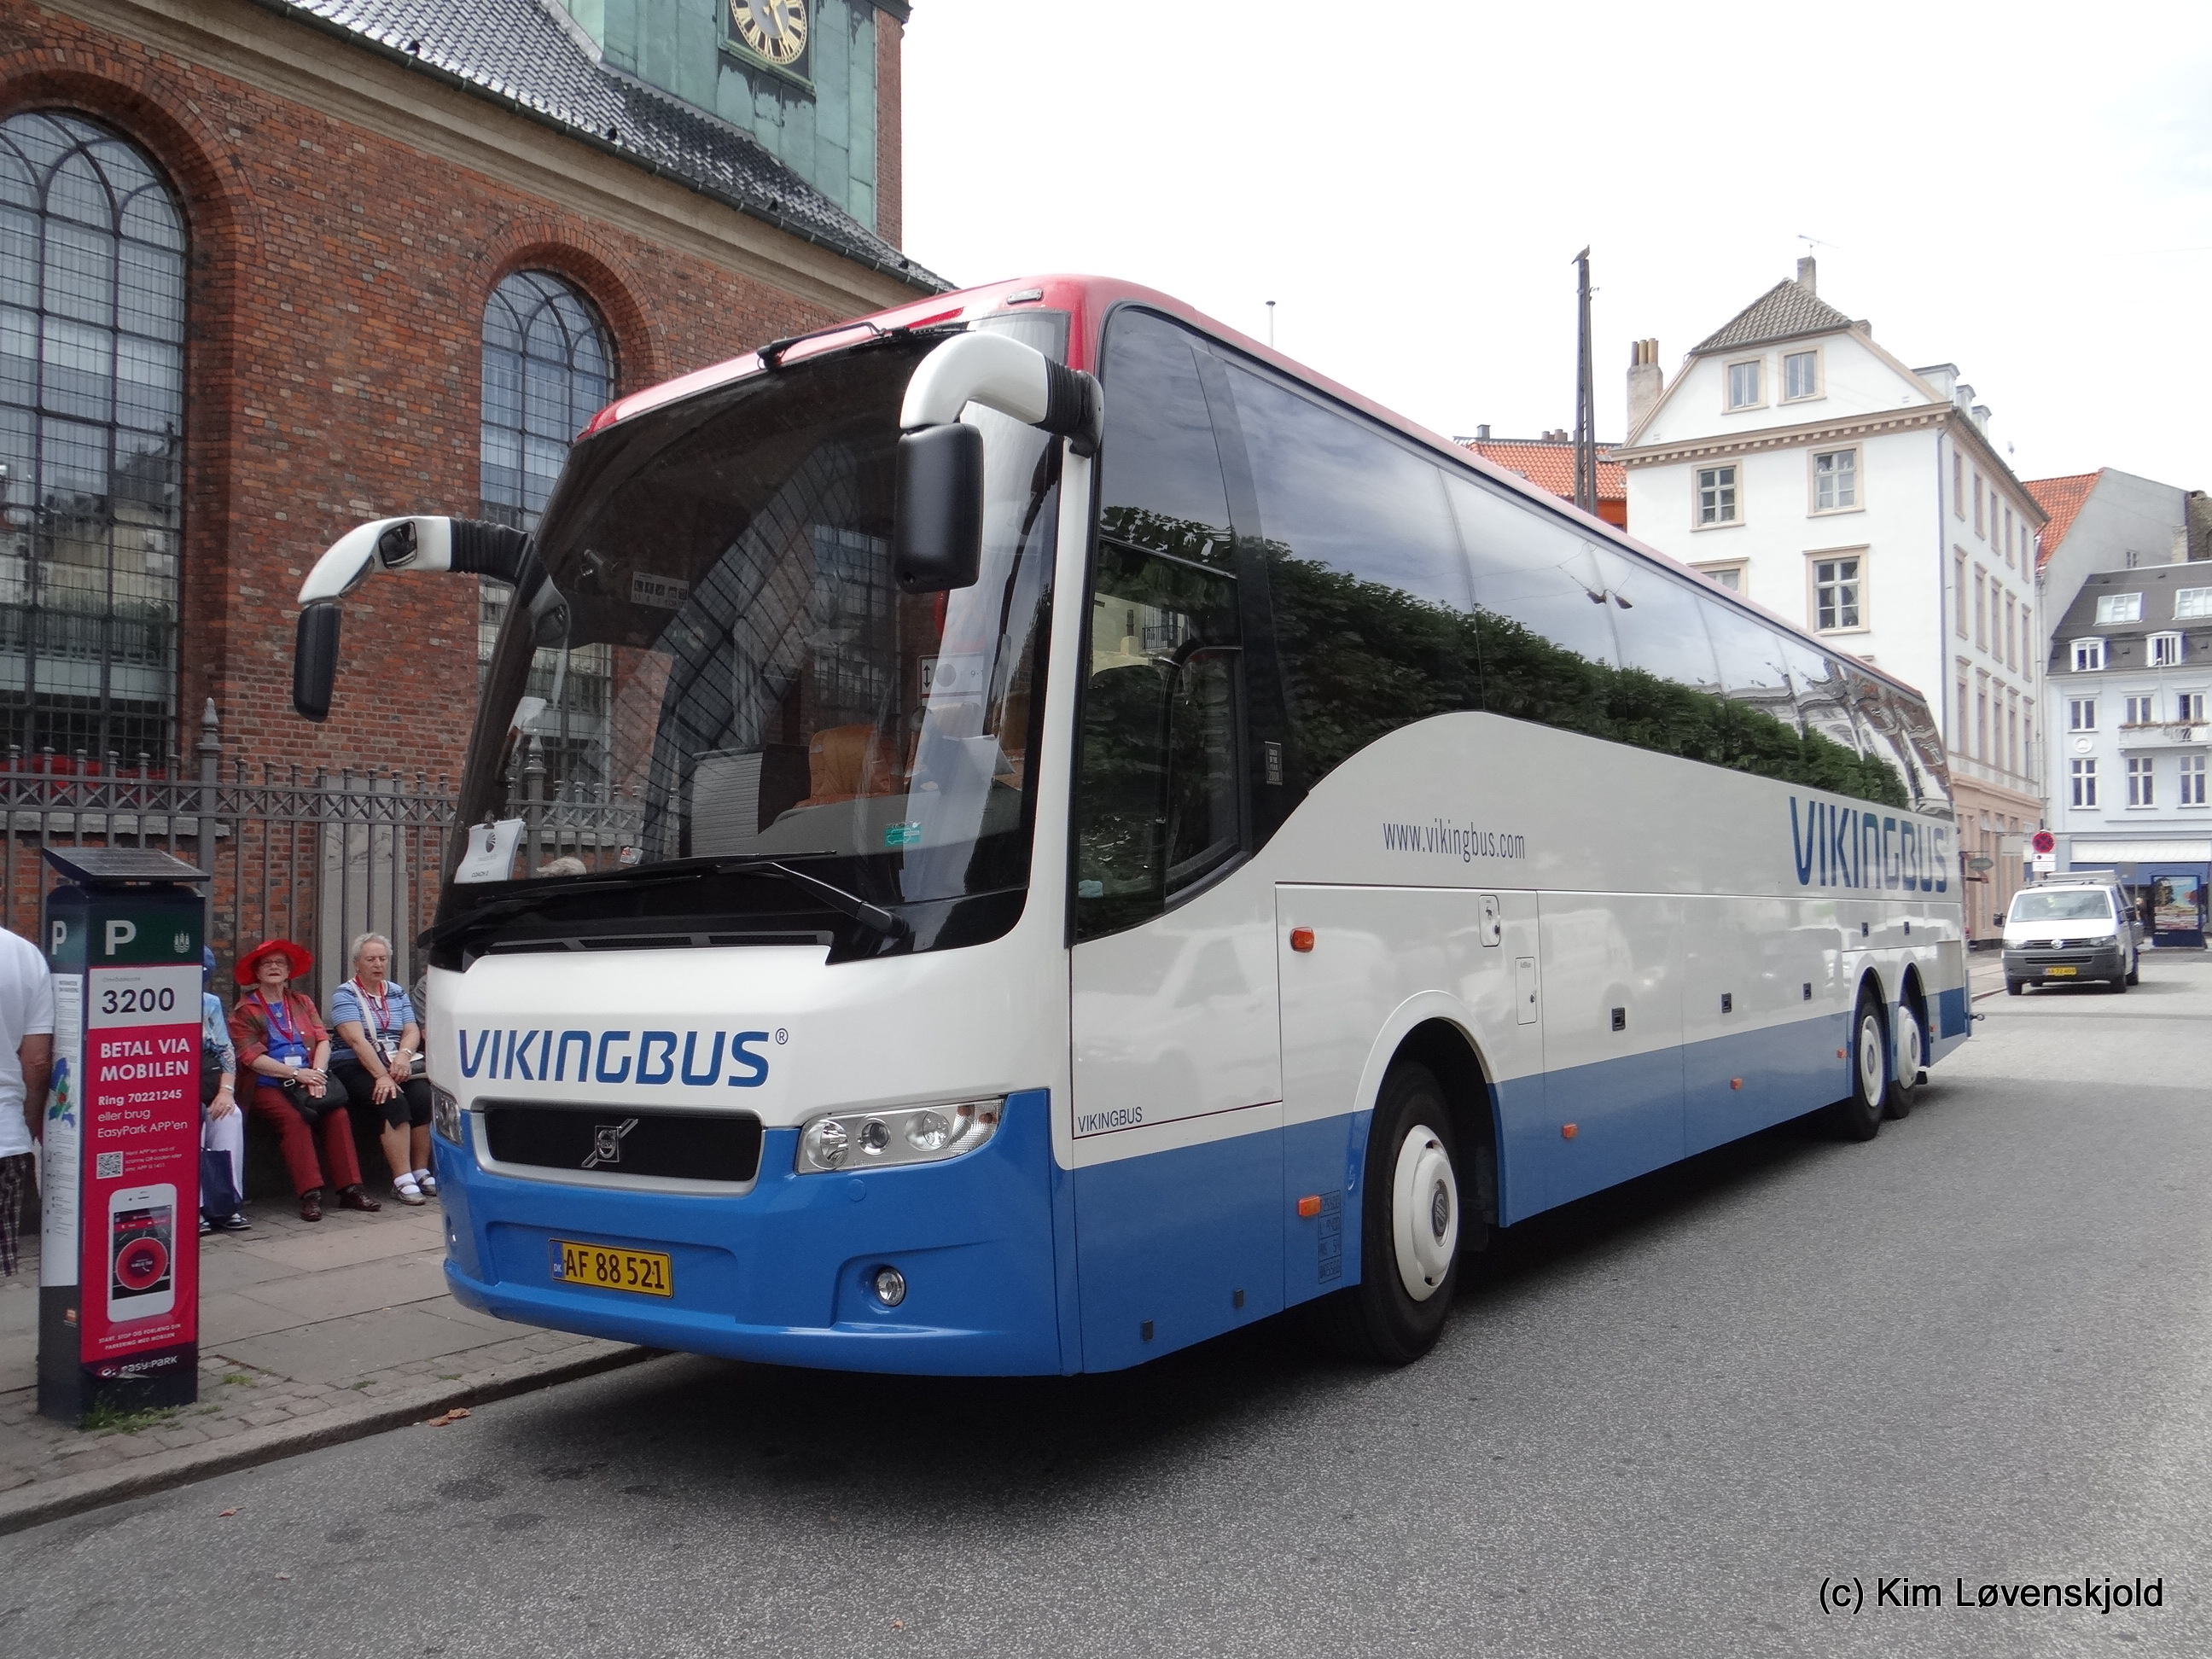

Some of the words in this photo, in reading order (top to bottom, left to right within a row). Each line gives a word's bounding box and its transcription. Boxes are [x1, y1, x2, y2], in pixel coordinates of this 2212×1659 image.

[1383, 818, 1525, 863] www.vikingbus.com
[52, 920, 67, 955] P
[106, 920, 137, 955] P
[102, 987, 175, 1015] 3200
[101, 1040, 154, 1059] BETAL
[157, 1038, 190, 1054] VIA
[100, 1060, 189, 1082] MOBILEN
[98, 1096, 125, 1107] Ring
[128, 1089, 183, 1103] 70221245
[97, 1111, 122, 1122] eller
[124, 1109, 151, 1120] brug
[1078, 1106, 1143, 1132] VIKINGBUS
[97, 1125, 148, 1138] EasyPark
[148, 1121, 188, 1132] APP'en
[554, 1263, 563, 1272] DK
[565, 1249, 590, 1278] AF
[596, 1252, 621, 1284] 88
[626, 1256, 665, 1289] 521
